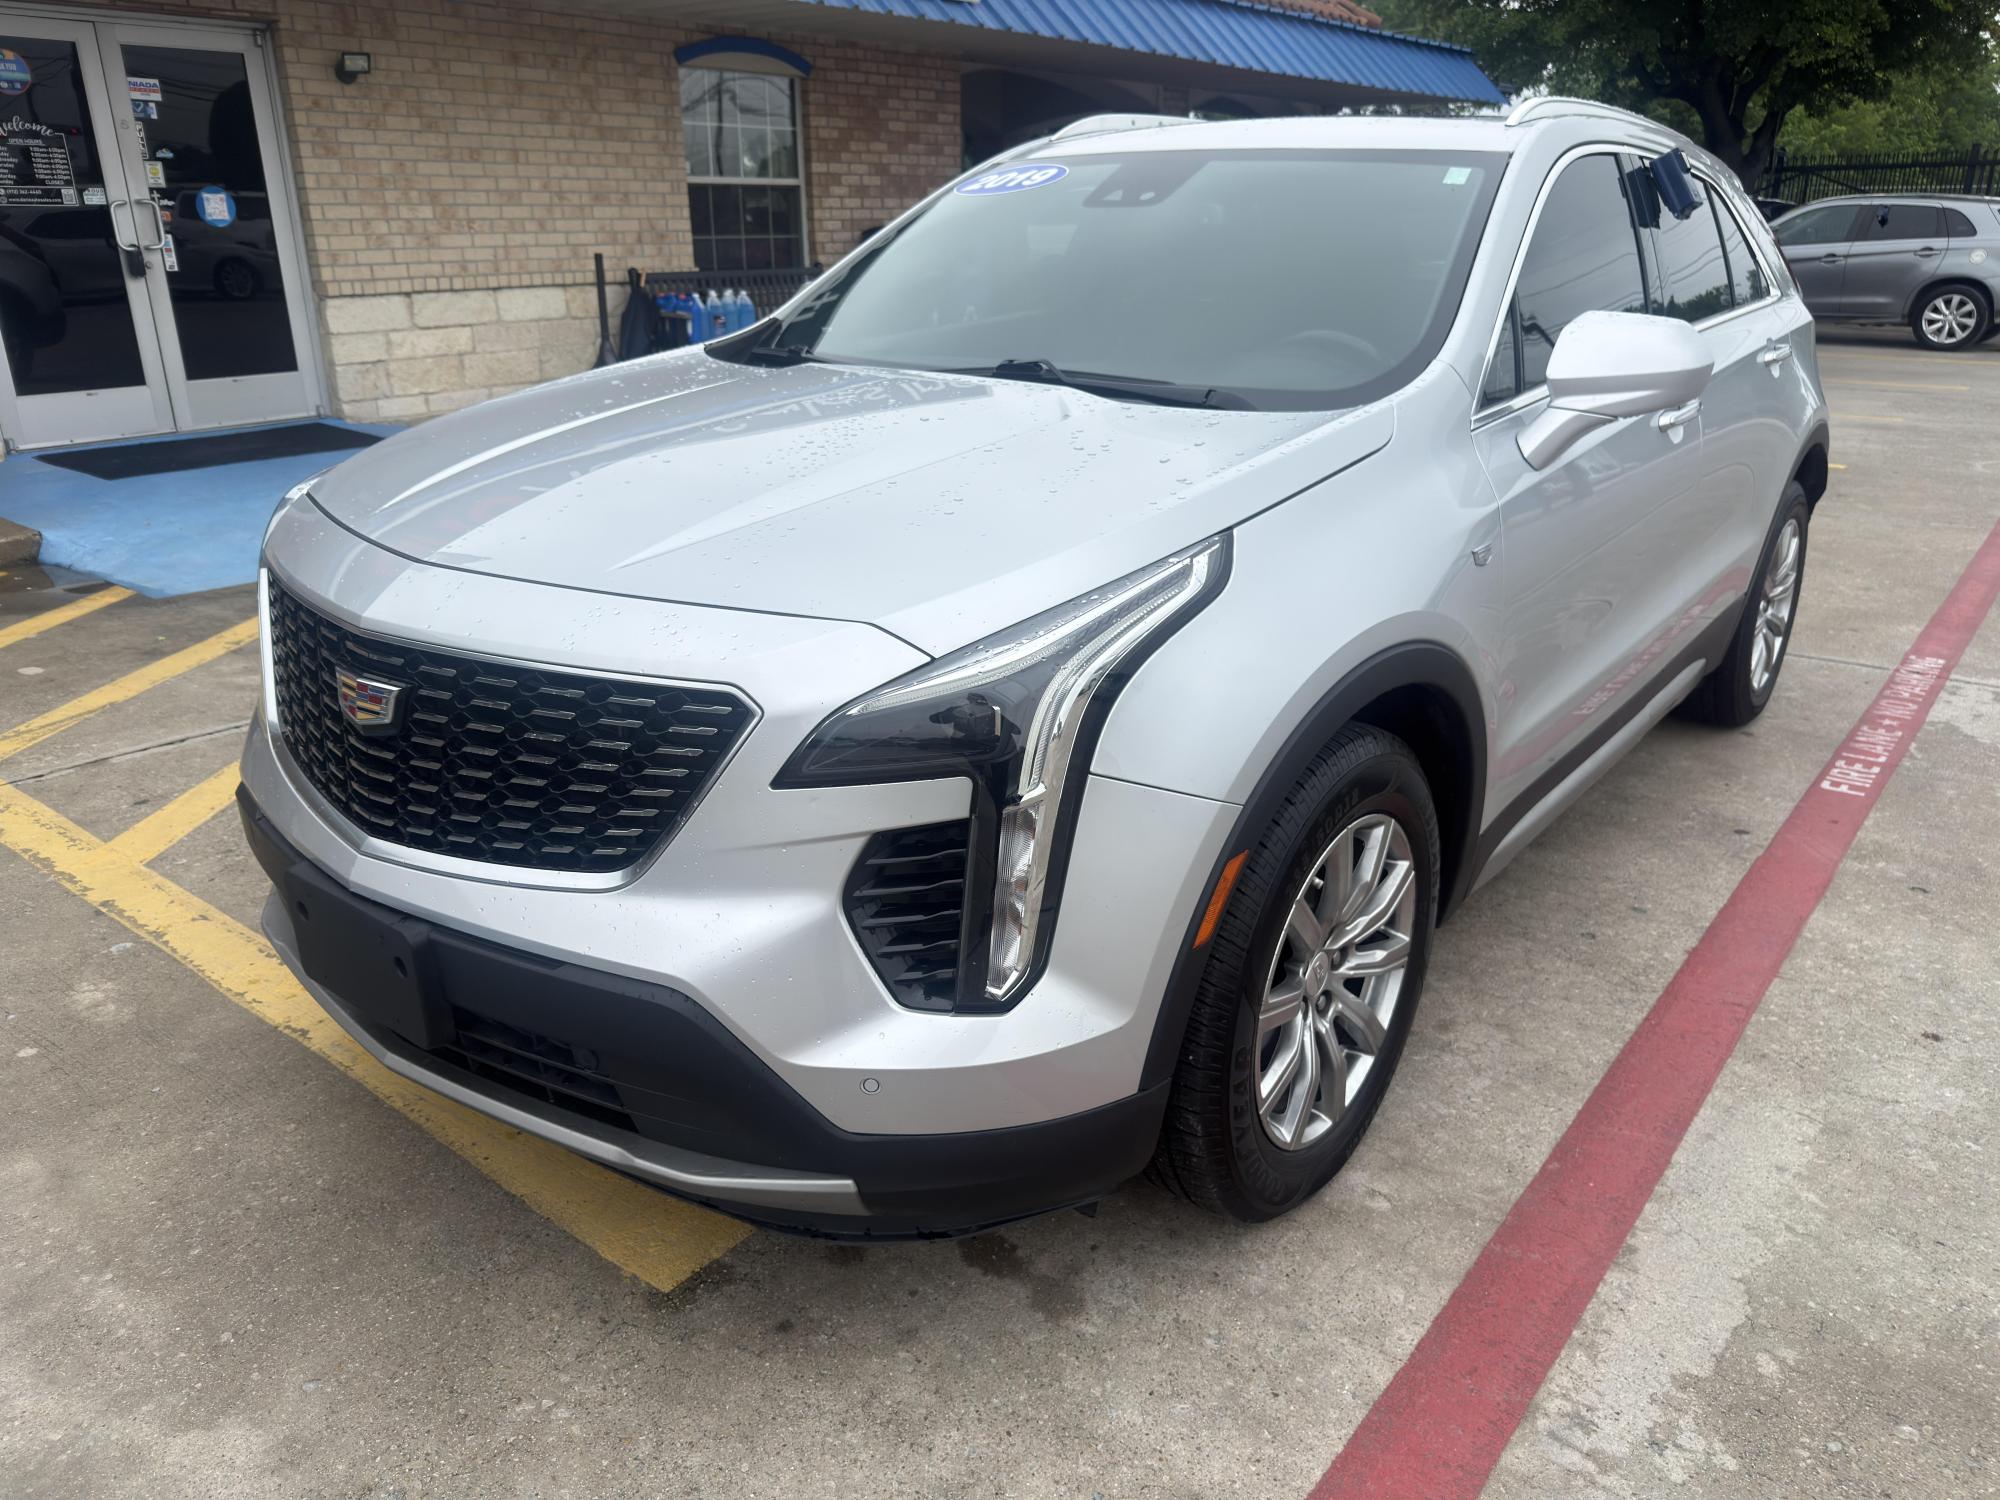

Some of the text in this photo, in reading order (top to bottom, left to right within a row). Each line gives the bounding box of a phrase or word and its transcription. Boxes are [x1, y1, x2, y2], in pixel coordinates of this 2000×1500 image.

[128, 80, 159, 89] NIADA
[960, 168, 1060, 192] 2019
[1873, 699, 1918, 720] NO
[1842, 725, 1903, 762] LANE
[1820, 760, 1881, 796] FIRE
